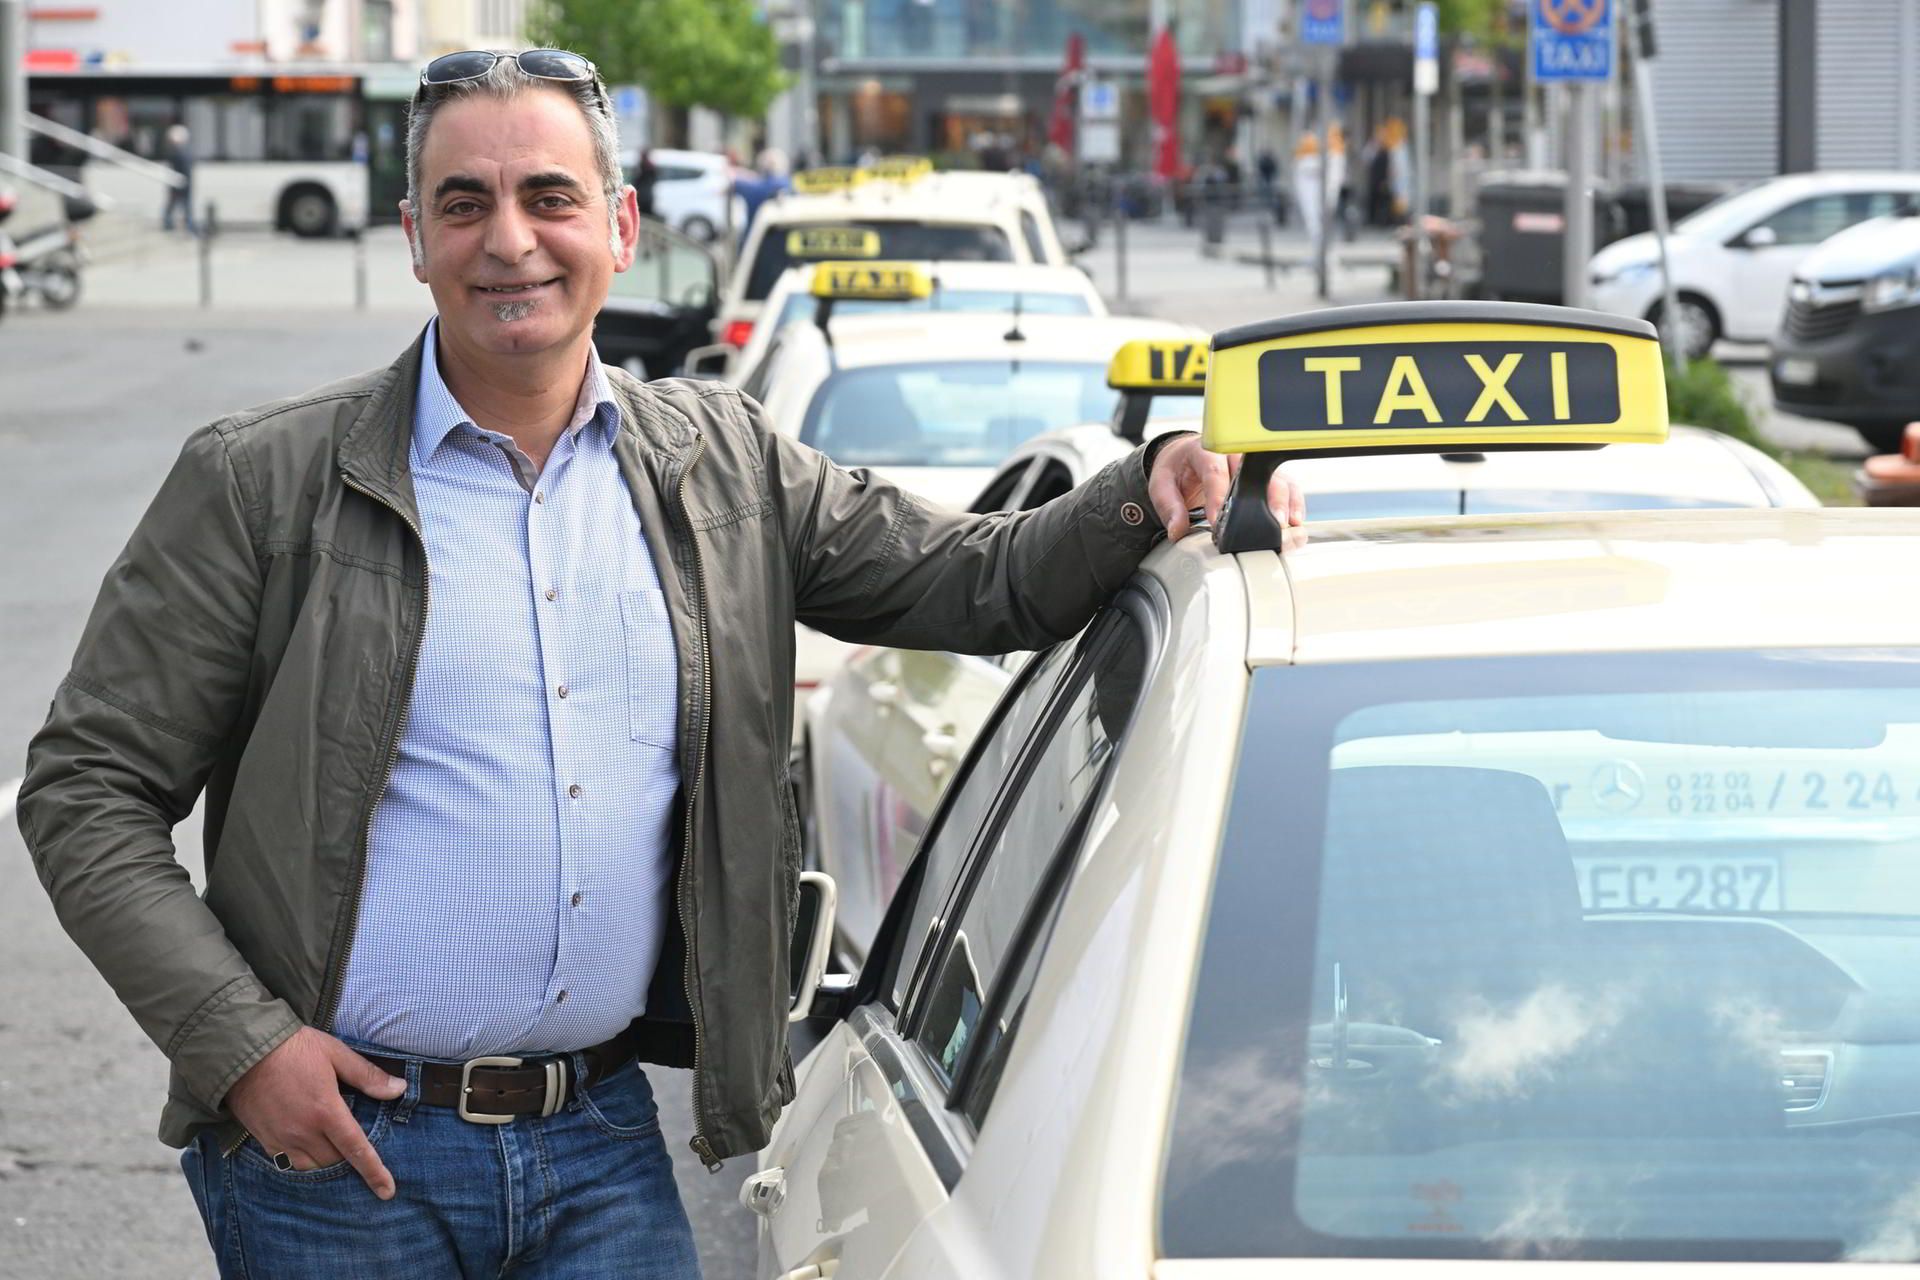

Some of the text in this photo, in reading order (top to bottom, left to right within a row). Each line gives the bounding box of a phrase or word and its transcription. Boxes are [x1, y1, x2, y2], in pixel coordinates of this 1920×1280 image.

[1541, 41, 1606, 70] TAXI
[1304, 352, 1571, 425] TAXI
[1676, 865, 1773, 912] 287
